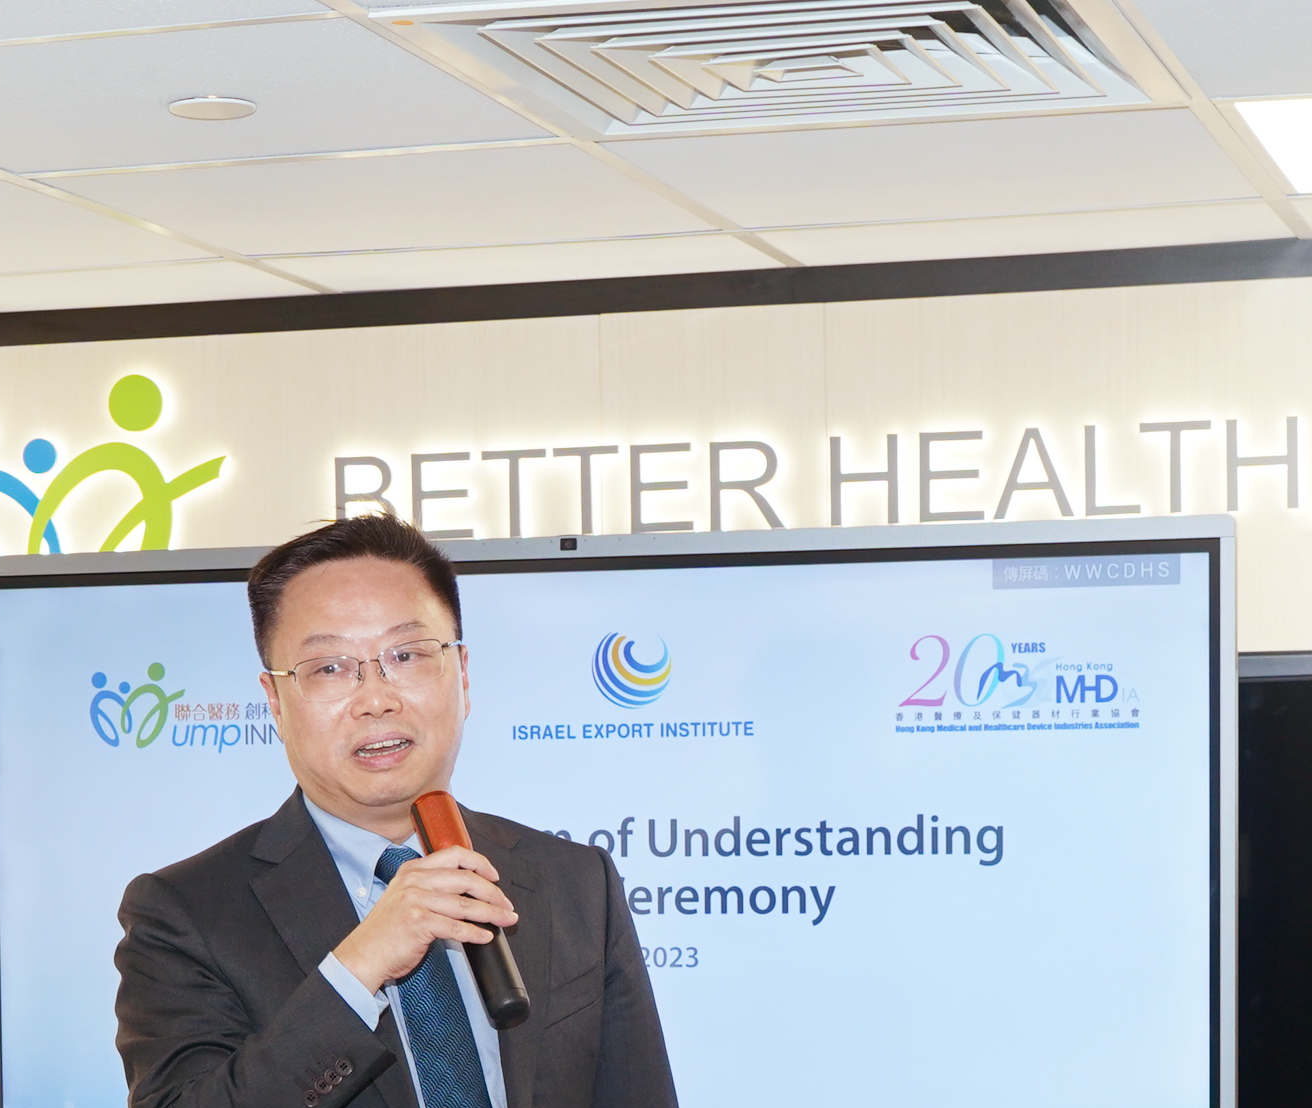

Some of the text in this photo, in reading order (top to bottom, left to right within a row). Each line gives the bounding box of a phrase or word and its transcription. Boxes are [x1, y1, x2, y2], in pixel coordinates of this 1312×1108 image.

[334, 441, 786, 538] BETTER
[1064, 561, 1170, 580] WWCDHS
[1011, 642, 1046, 653] YEARS
[1055, 661, 1114, 673] Hong Kong
[512, 721, 755, 740] ISRAEL EXPORT INSTITUTE
[895, 721, 1140, 734] Hong Kong Medical and Healthcare Device Industries Association
[588, 814, 1005, 866] of Understanding
[621, 877, 836, 926] eremony
[641, 946, 700, 968] 2023
